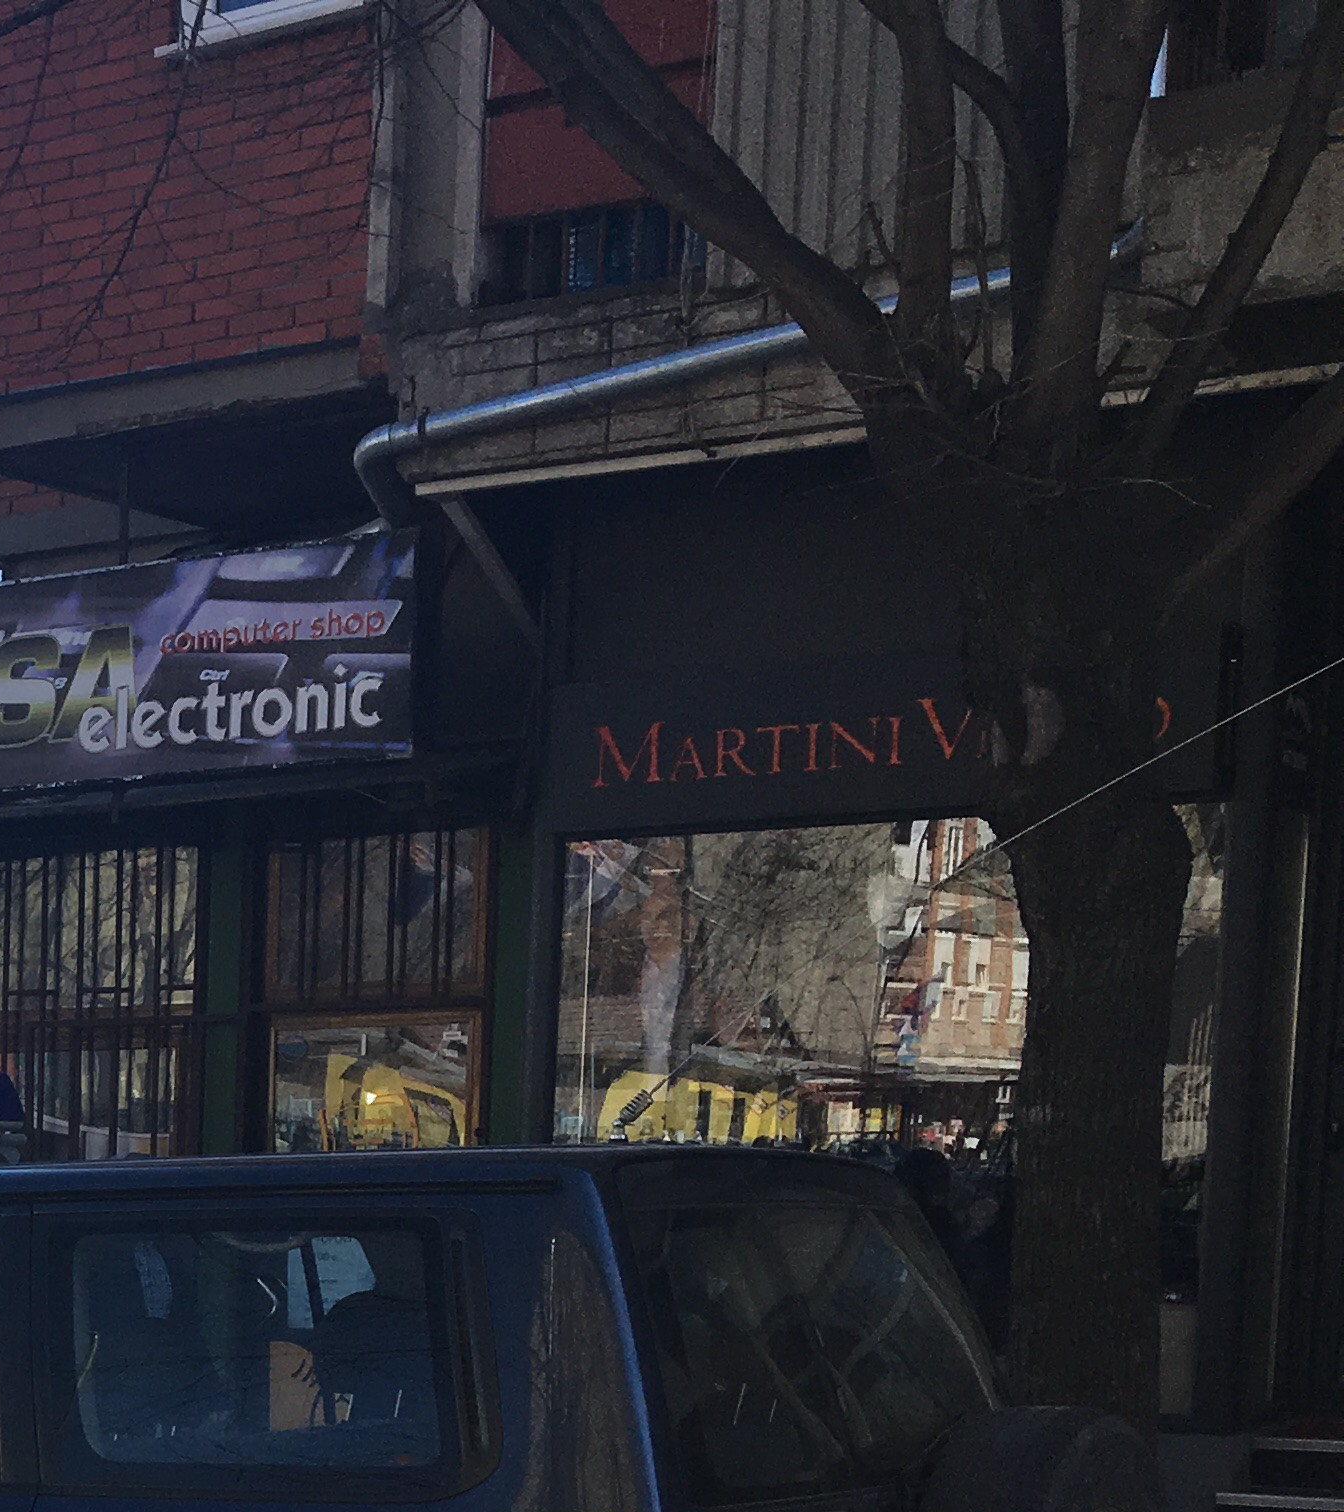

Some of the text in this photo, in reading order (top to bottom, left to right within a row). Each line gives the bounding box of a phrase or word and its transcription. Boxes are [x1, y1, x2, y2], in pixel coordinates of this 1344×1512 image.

[159, 607, 385, 656] computer shop
[77, 661, 386, 755] electronic
[591, 716, 903, 788] MARTINI
